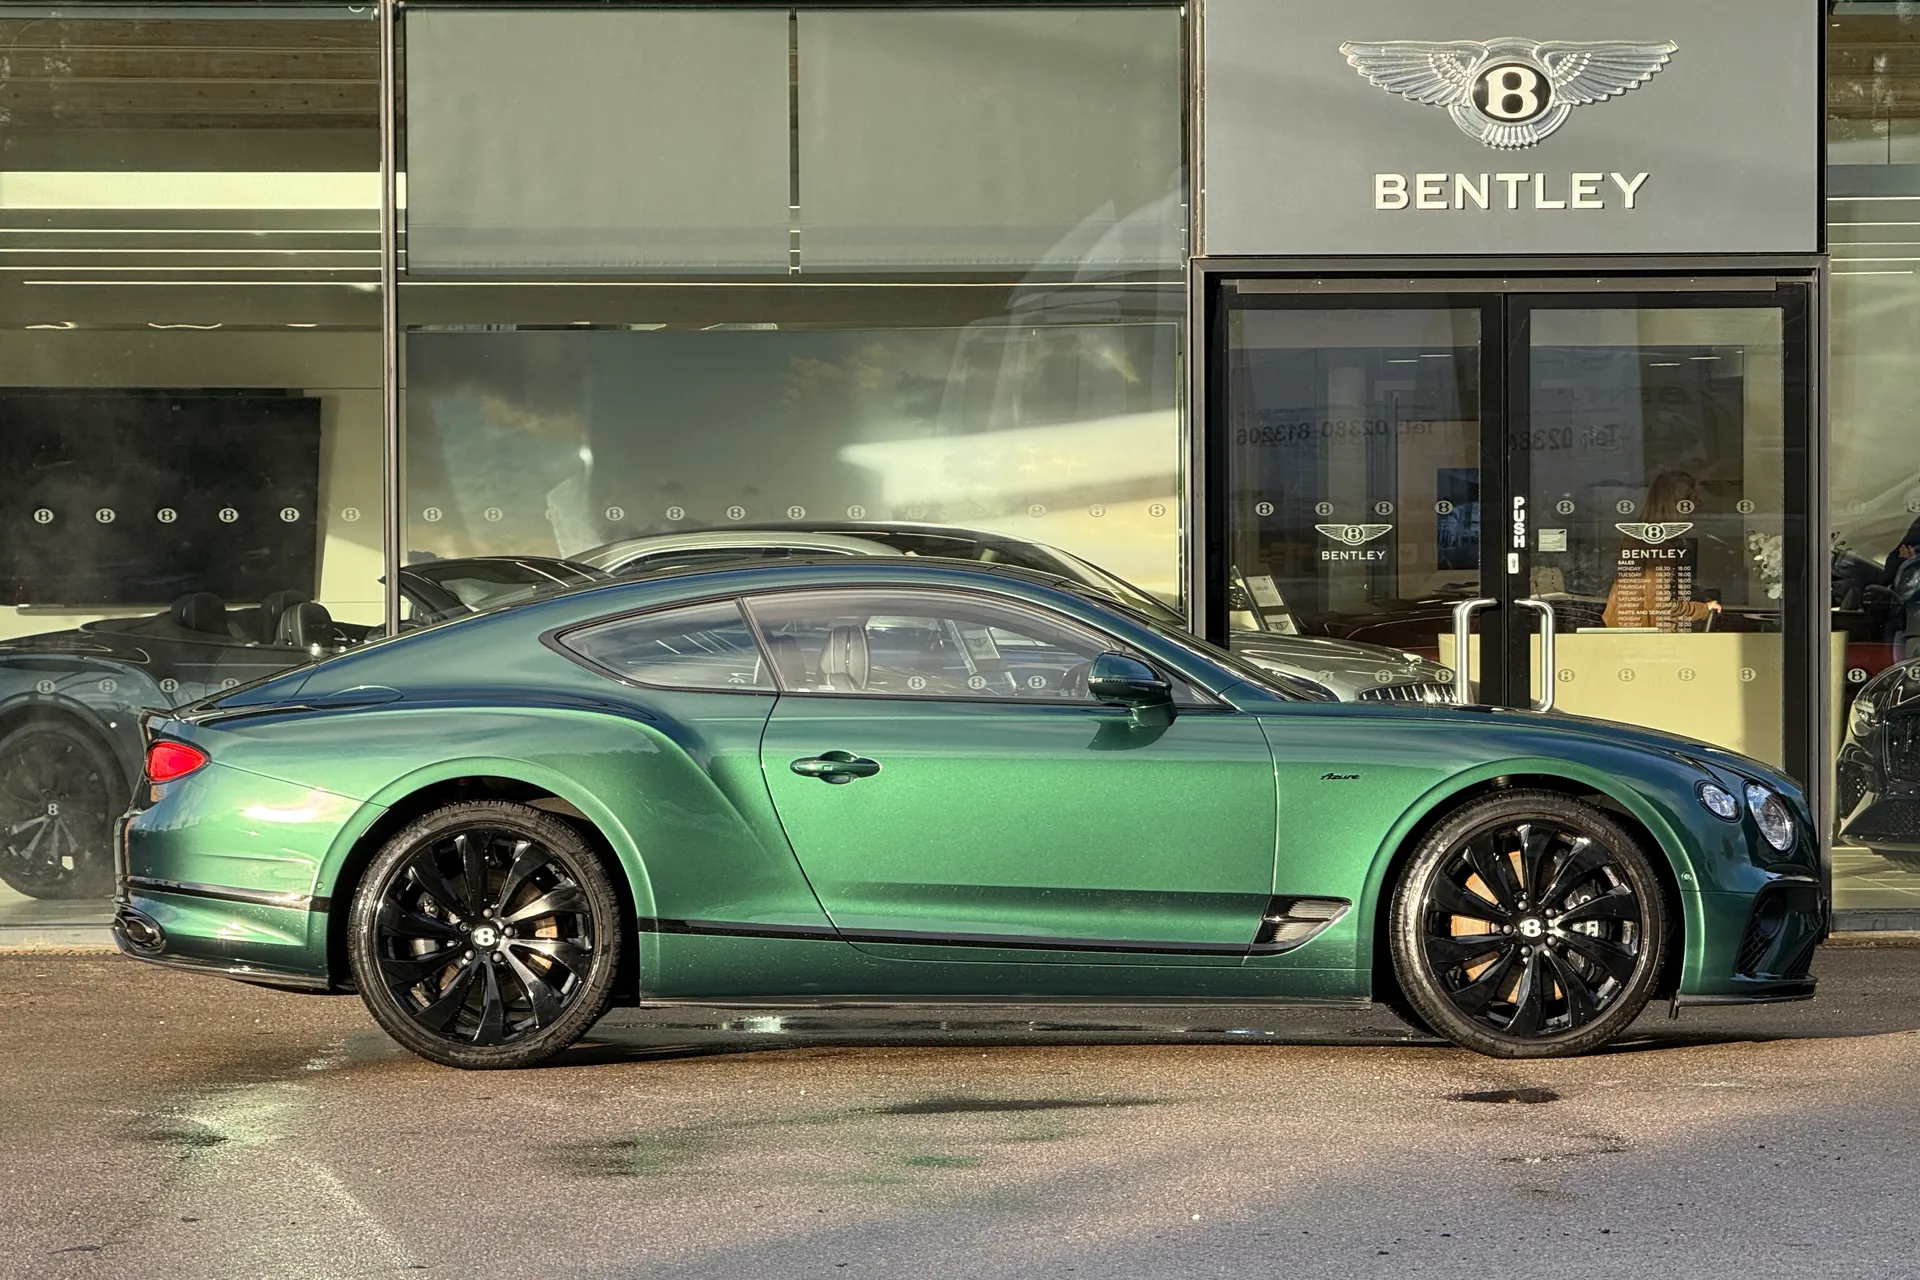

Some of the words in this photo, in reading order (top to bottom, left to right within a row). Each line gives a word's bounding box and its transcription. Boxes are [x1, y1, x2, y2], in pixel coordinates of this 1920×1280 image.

[1485, 66, 1538, 119] B
[1375, 172, 1650, 211] BENTLEY
[1513, 496, 1526, 548] PUSH
[1321, 551, 1386, 560] BENTLEY
[1622, 549, 1687, 558] BENTLEY
[1320, 772, 1360, 780] Azure
